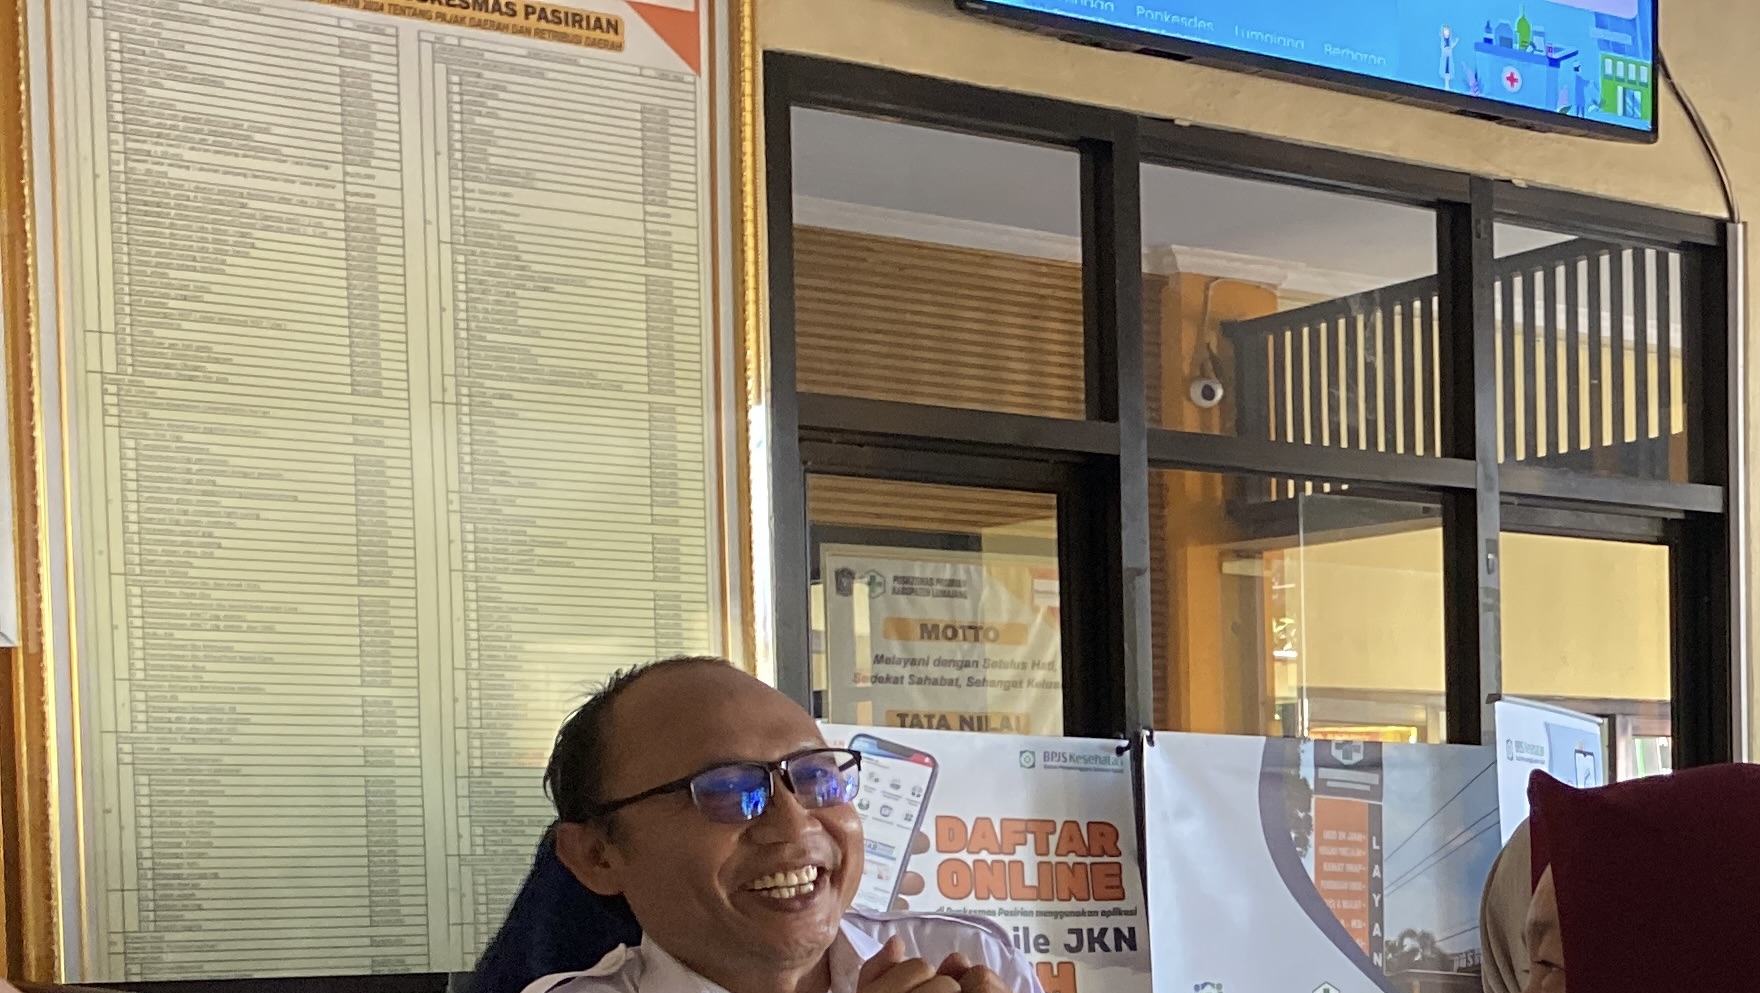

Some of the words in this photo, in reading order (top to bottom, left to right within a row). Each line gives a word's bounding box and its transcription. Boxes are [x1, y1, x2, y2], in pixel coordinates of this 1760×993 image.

[523, 4, 619, 35] PASIRIAN
[919, 622, 1000, 643] MOTTO
[873, 653, 930, 668] Melayani
[933, 655, 979, 671] dengan
[896, 712, 947, 730] TATA
[1043, 750, 1068, 764] BPJS
[1068, 752, 1124, 767] Kesehatan
[935, 815, 1122, 857] DAFTAR
[937, 858, 1125, 901] ONLINE
[1012, 926, 1050, 954] ile
[1063, 926, 1138, 954] JKN
